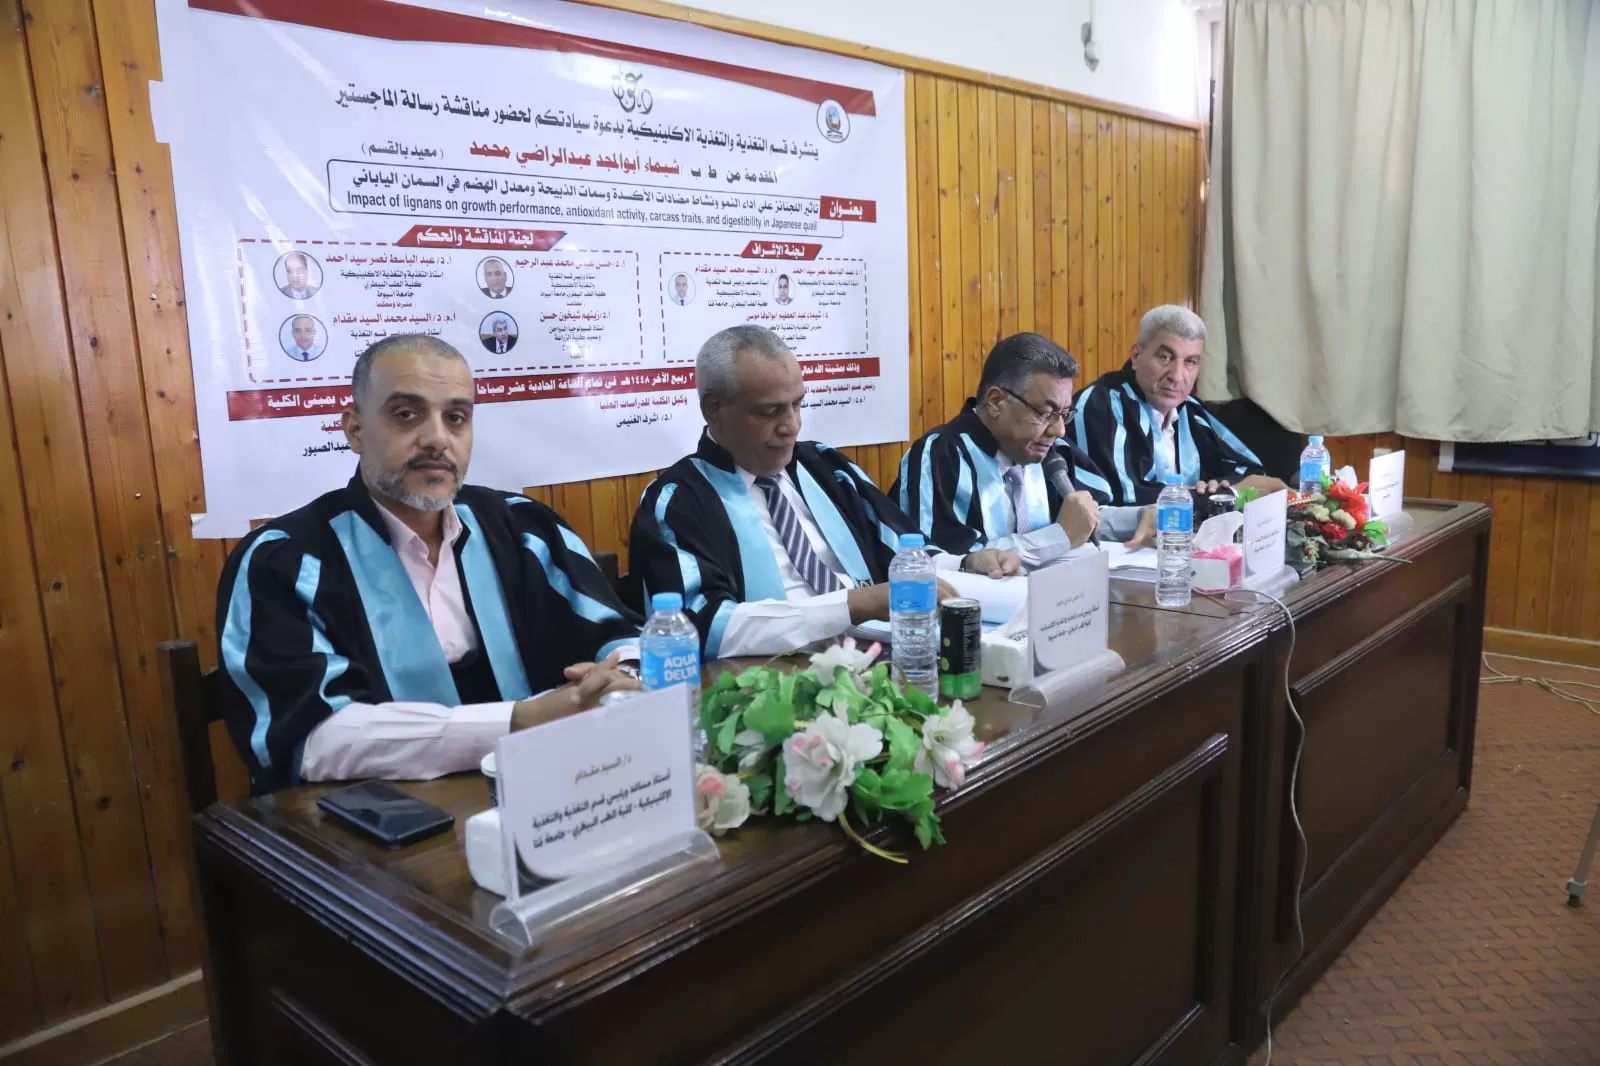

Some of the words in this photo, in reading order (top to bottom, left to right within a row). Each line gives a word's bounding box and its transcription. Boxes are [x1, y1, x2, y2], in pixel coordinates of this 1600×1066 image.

[335, 82, 397, 110] الماجستير
[400, 89, 439, 116] رسالة
[441, 94, 490, 118] مناقشة
[492, 104, 531, 124] لحضور
[534, 109, 590, 134] سيادتكم
[593, 113, 625, 139] بدعوة
[627, 118, 695, 144] الاكلينيكية
[696, 127, 734, 152] والتغذية
[736, 133, 768, 154] التغذية
[770, 139, 788, 156] قسم
[469, 140, 511, 159] محمد
[644, 156, 680, 178] شيماء
[745, 168, 778, 184] المقدمة
[352, 168, 398, 188] الياباني
[401, 173, 444, 189] السمان
[446, 174, 461, 194] في
[463, 177, 498, 194] الهضم
[726, 170, 741, 184] من
[500, 179, 536, 197] ومعدل
[536, 181, 577, 199] الذبيحة
[347, 190, 387, 209] Impact
[389, 193, 401, 208] of
[403, 194, 443, 212] lignans
[445, 199, 458, 211] on
[461, 199, 497, 214] growth
[500, 201, 564, 217] performance,
[566, 204, 614, 220] antioxidant
[616, 206, 648, 223] activity,
[649, 210, 680, 223] carcass
[681, 211, 705, 225] traits,
[706, 214, 720, 225] and
[721, 214, 762, 229] digestibility
[763, 217, 770, 228] in
[771, 217, 802, 231] Japanese
[803, 220, 817, 232] quail
[828, 199, 864, 220] بعنوان
[416, 227, 463, 247] والحكم
[464, 227, 507, 245] المناقشة
[508, 230, 534, 249] لجنة
[784, 244, 805, 260] لجنة
[814, 363, 824, 374] الله
[506, 381, 526, 396] عشر
[527, 379, 557, 394] الحادية
[670, 374, 688, 386] ربيع
[267, 393, 301, 411] الكلية
[664, 654, 697, 668] AQUA
